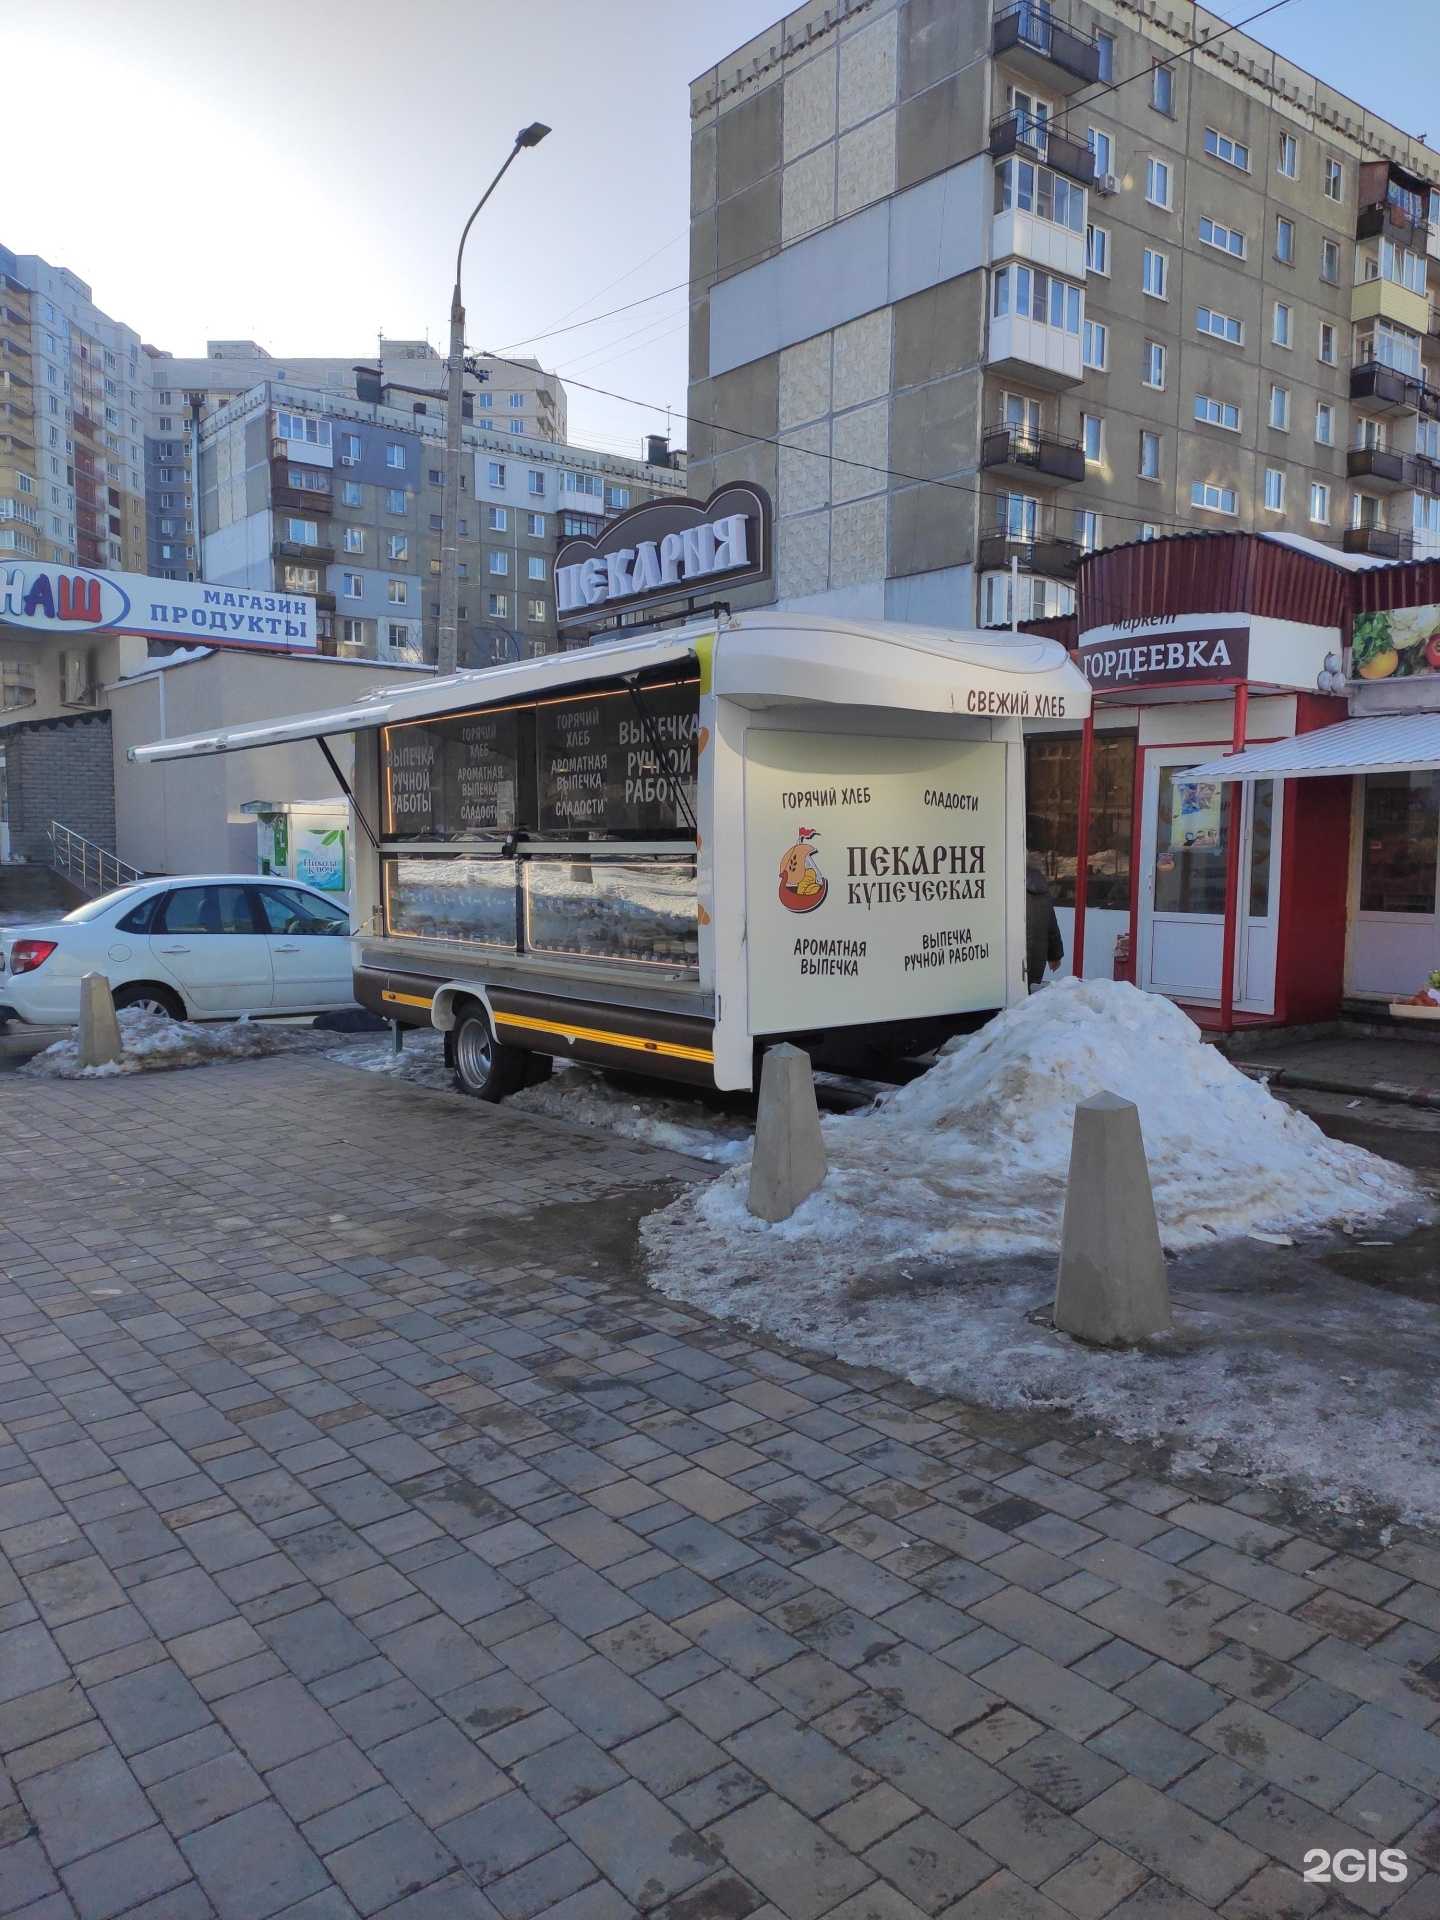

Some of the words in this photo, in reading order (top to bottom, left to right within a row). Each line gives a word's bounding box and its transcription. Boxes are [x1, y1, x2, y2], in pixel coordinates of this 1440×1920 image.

[557, 514, 750, 611] ПЕКАРНЯ
[0, 567, 102, 622] НАШ
[204, 590, 306, 615] МАГАЗИН
[150, 604, 306, 638] ПРОДУКТЫ
[1083, 640, 1231, 680] ГОРДЕЕВКА
[967, 690, 1029, 715] СВЕЖИЙ
[1035, 694, 1065, 717] ХЛЕБ
[558, 707, 599, 729] ГОРЯЧИЙ
[566, 730, 590, 747] ХЛЕБ
[458, 765, 504, 781] АРОМАТНАЯ
[552, 754, 607, 774] АРОМАТНАЯ
[393, 769, 430, 793] РУЧНОЙ
[557, 773, 601, 791] ВЫПЕЧКА
[392, 792, 431, 814] РАБОТЫ
[555, 799, 604, 816] СЛАДОСТИ
[782, 788, 837, 809] ГОРЯЧИЙ
[842, 787, 871, 805] ХЛЕБ
[924, 790, 978, 812] СЛАДОСТИ
[847, 846, 986, 876] ПЕКАРНЯ
[848, 879, 986, 910] КУПЕЧЕСКАЯ
[794, 938, 867, 957] АРОМАТНАЯ
[922, 929, 972, 949] ВЫПЕЧКА
[800, 959, 859, 976] ВЫПЕЧКА
[904, 950, 945, 972] РУЧНОЙ
[949, 944, 989, 964] РАБОТЫ
